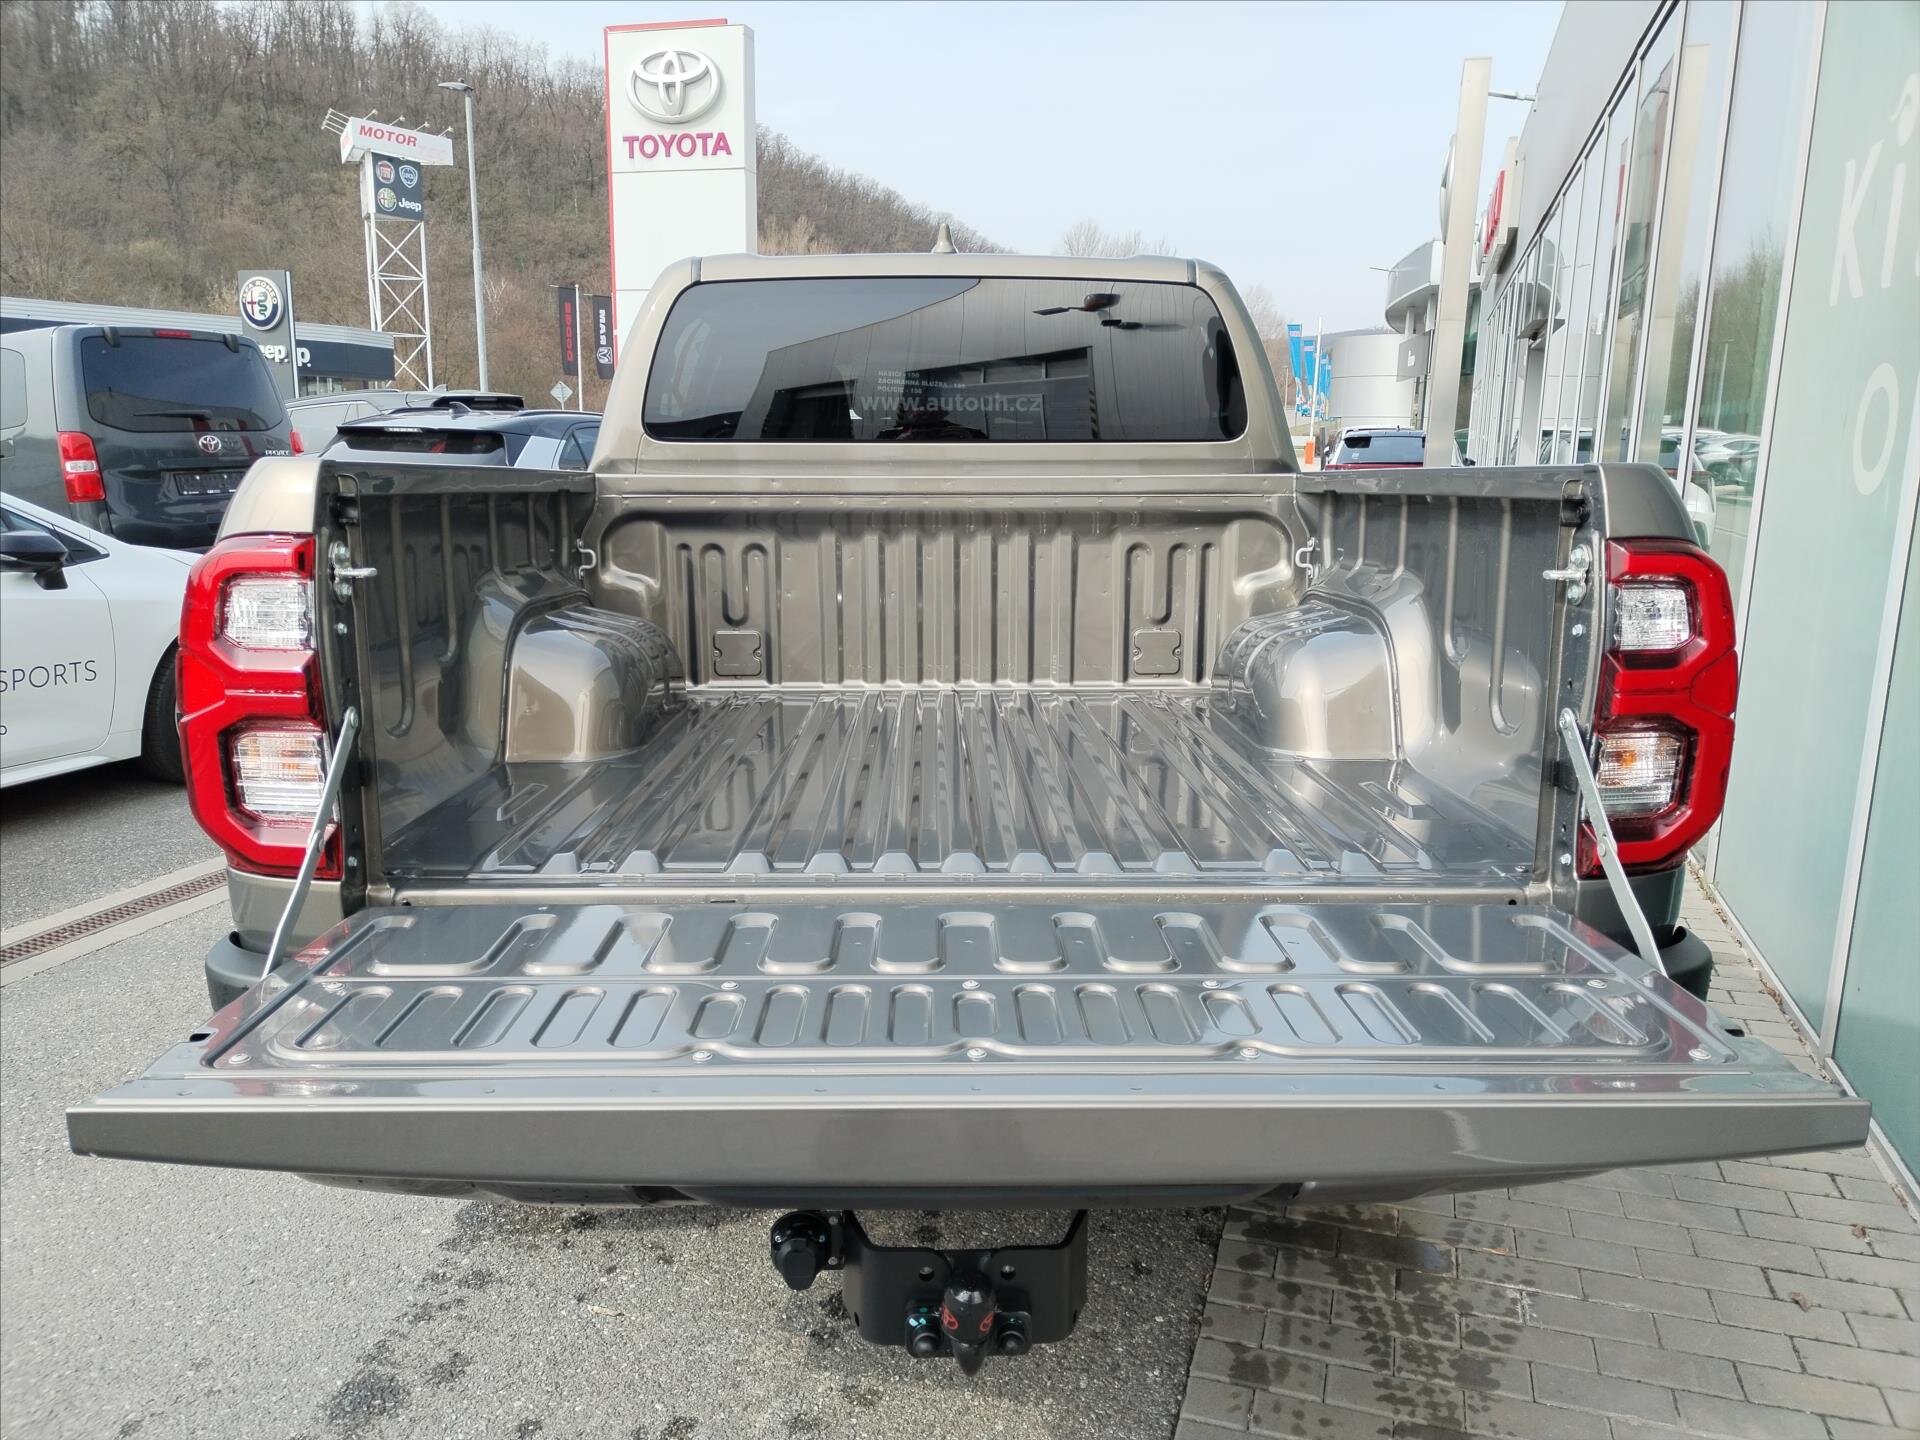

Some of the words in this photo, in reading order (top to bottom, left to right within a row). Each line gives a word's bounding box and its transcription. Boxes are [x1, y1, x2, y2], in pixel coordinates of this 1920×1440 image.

[359, 124, 418, 147] MOTOR
[623, 132, 732, 159] TOYOTA
[398, 197, 422, 213] Jeep
[255, 280, 278, 305] ROMEO
[0, 659, 97, 693] SPORTS
